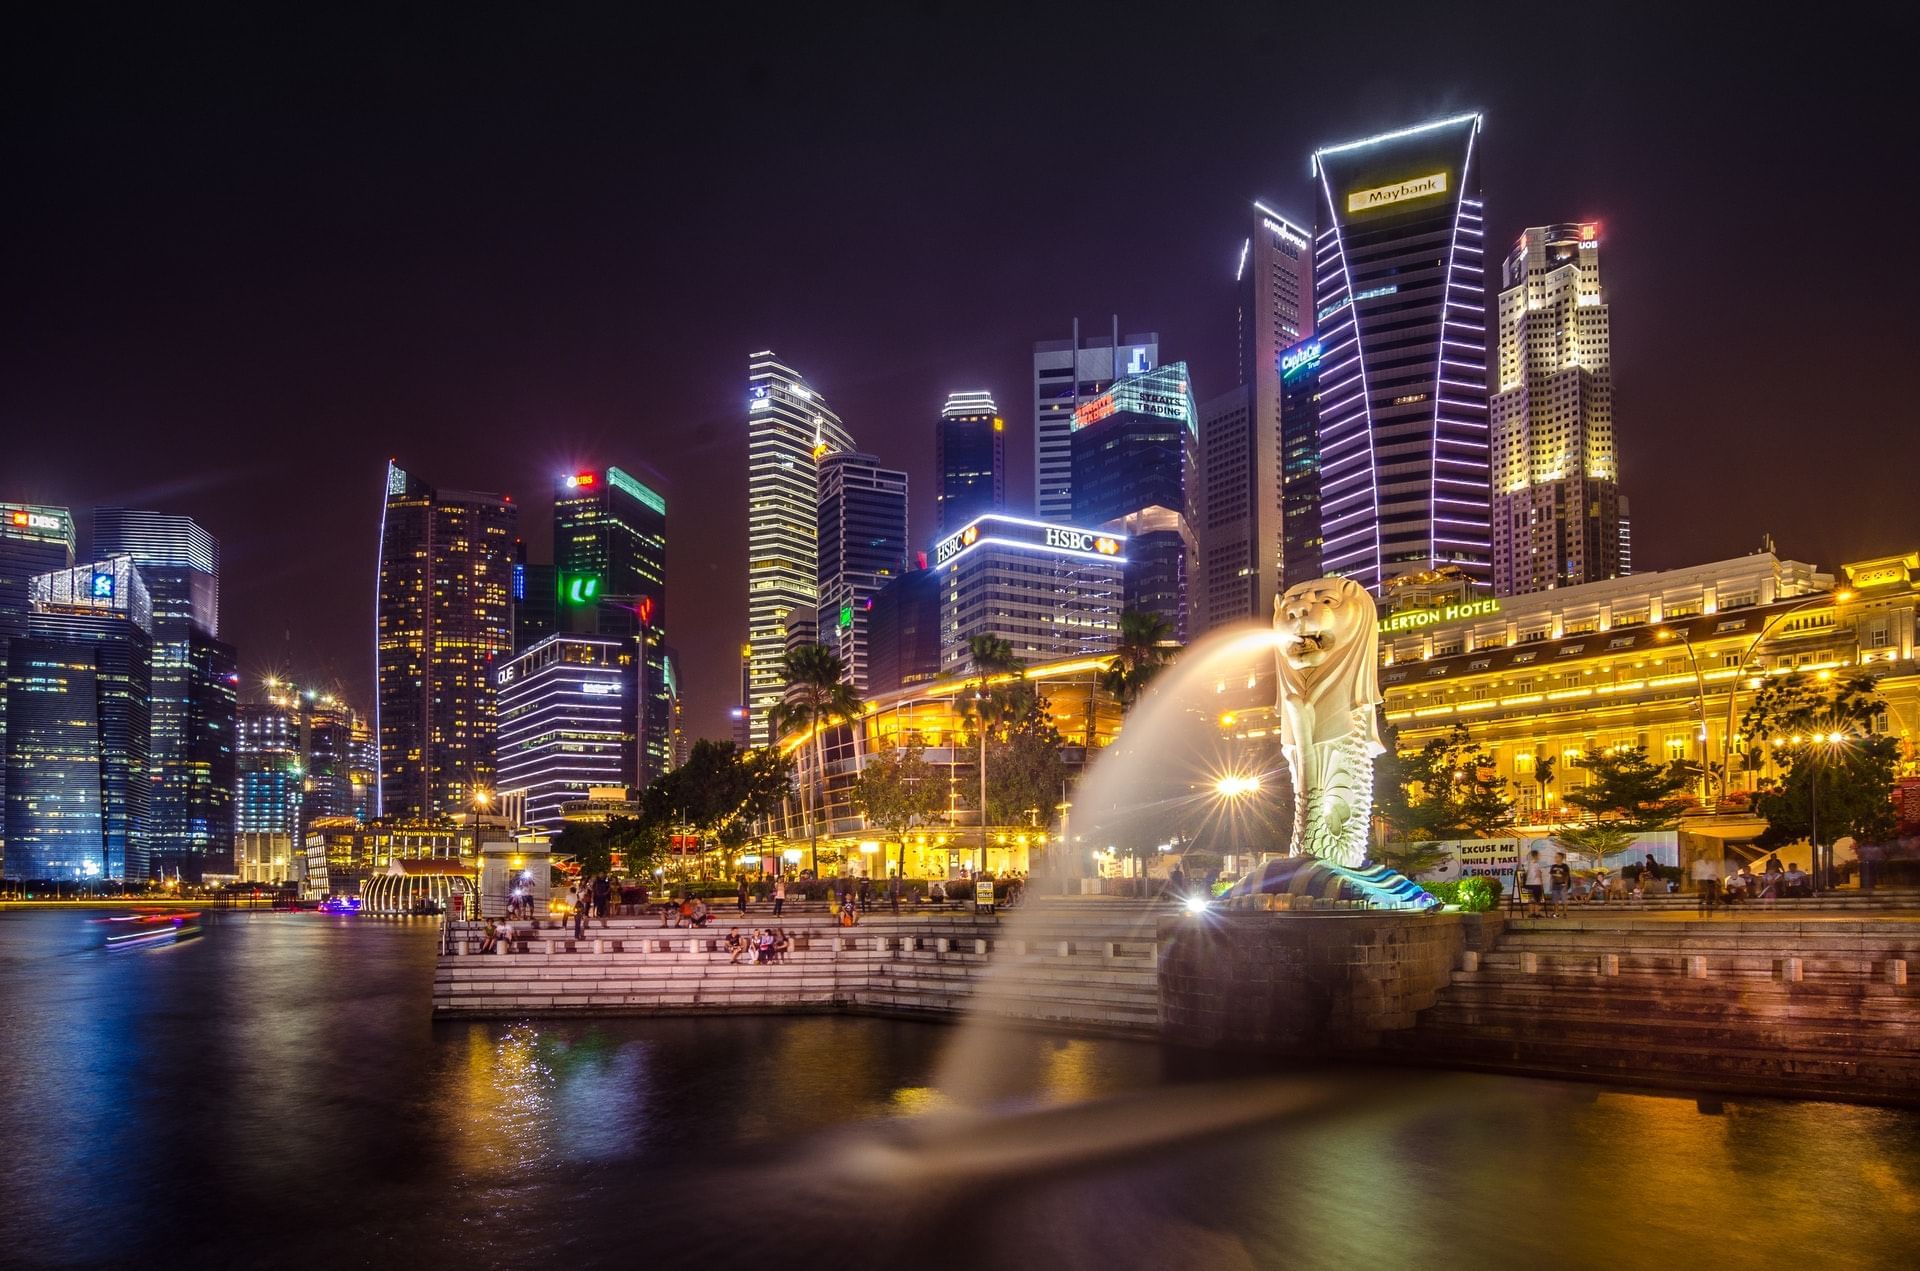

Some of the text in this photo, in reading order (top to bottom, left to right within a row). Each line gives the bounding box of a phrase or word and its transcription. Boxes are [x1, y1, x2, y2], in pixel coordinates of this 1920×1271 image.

[1369, 179, 1437, 202] Maybank
[1579, 241, 1598, 249] UOB
[1136, 402, 1181, 416] TRADING
[28, 514, 59, 529] DBS
[1046, 528, 1093, 551] HSBC
[937, 534, 963, 563] HSBC
[1377, 599, 1500, 633] LLERTON HOTEL
[1500, 844, 1515, 853] ME
[1462, 856, 1488, 865] WHILE
[1498, 855, 1518, 864] TAKE
[1462, 867, 1514, 877] A SHOWER
